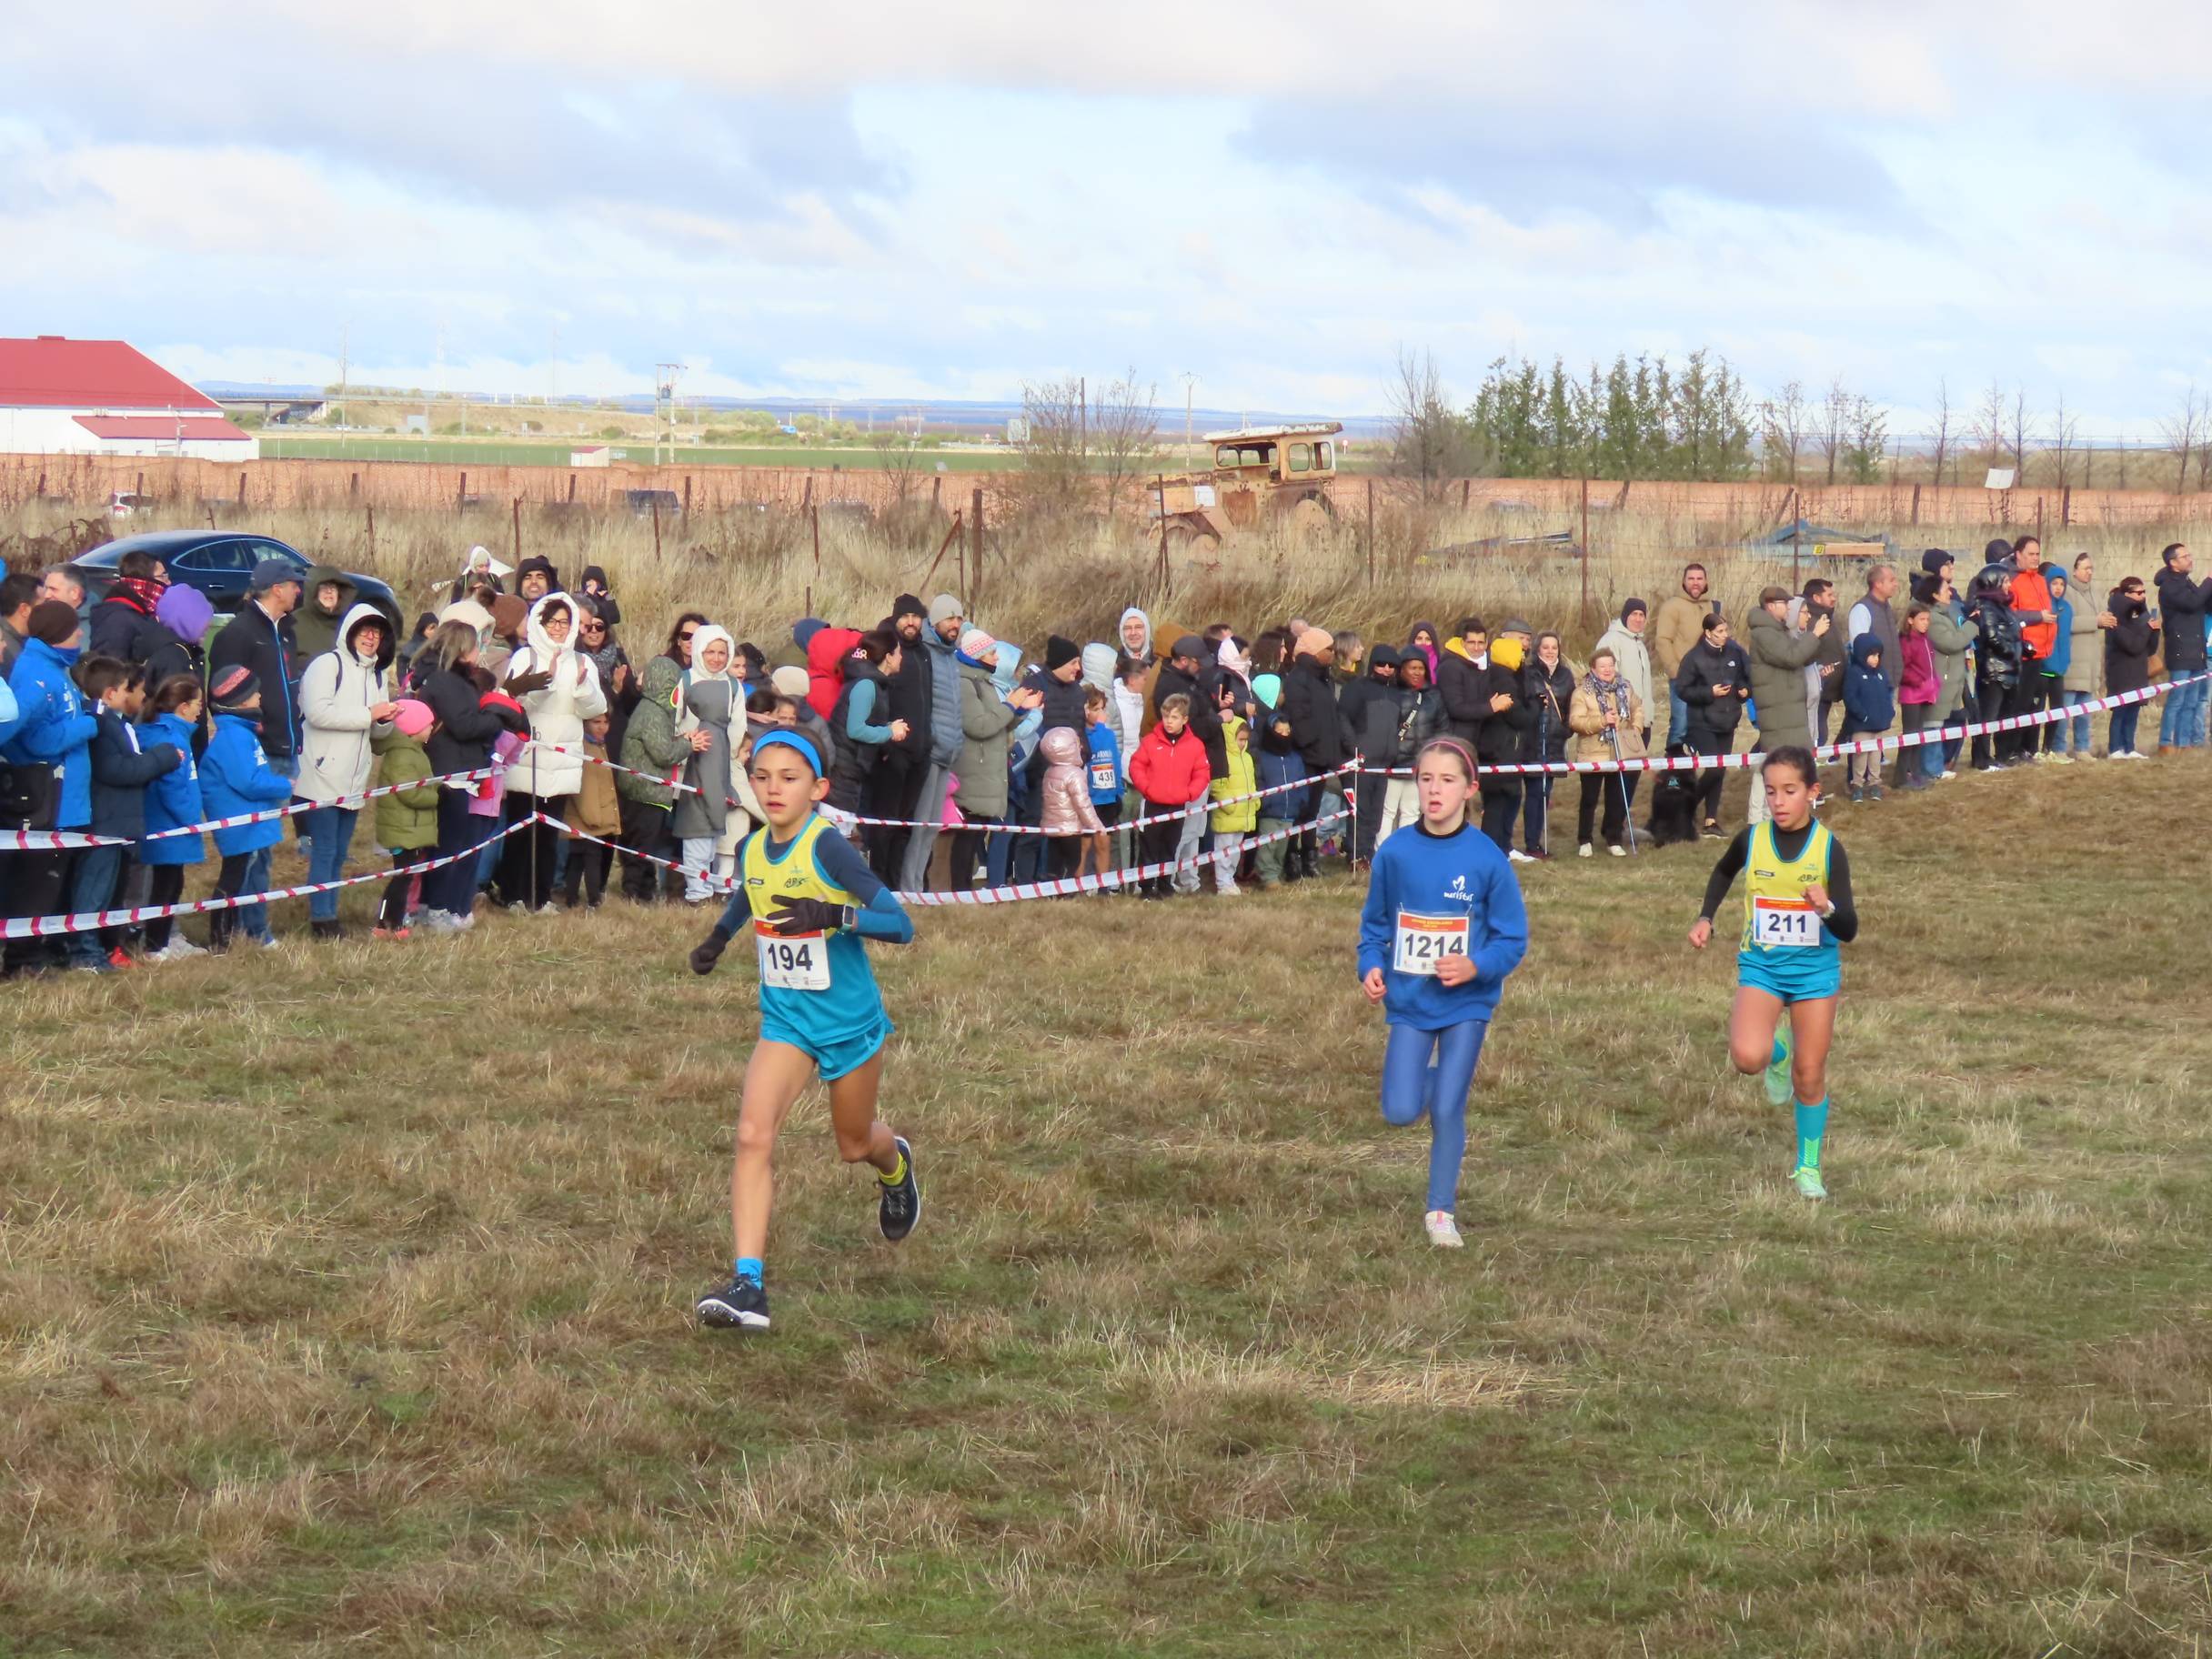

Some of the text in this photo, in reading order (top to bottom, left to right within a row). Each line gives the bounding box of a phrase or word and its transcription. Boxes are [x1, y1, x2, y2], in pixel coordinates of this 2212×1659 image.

[1768, 913, 1806, 933] 211
[768, 942, 813, 971] 194
[1405, 933, 1464, 959] 1214
